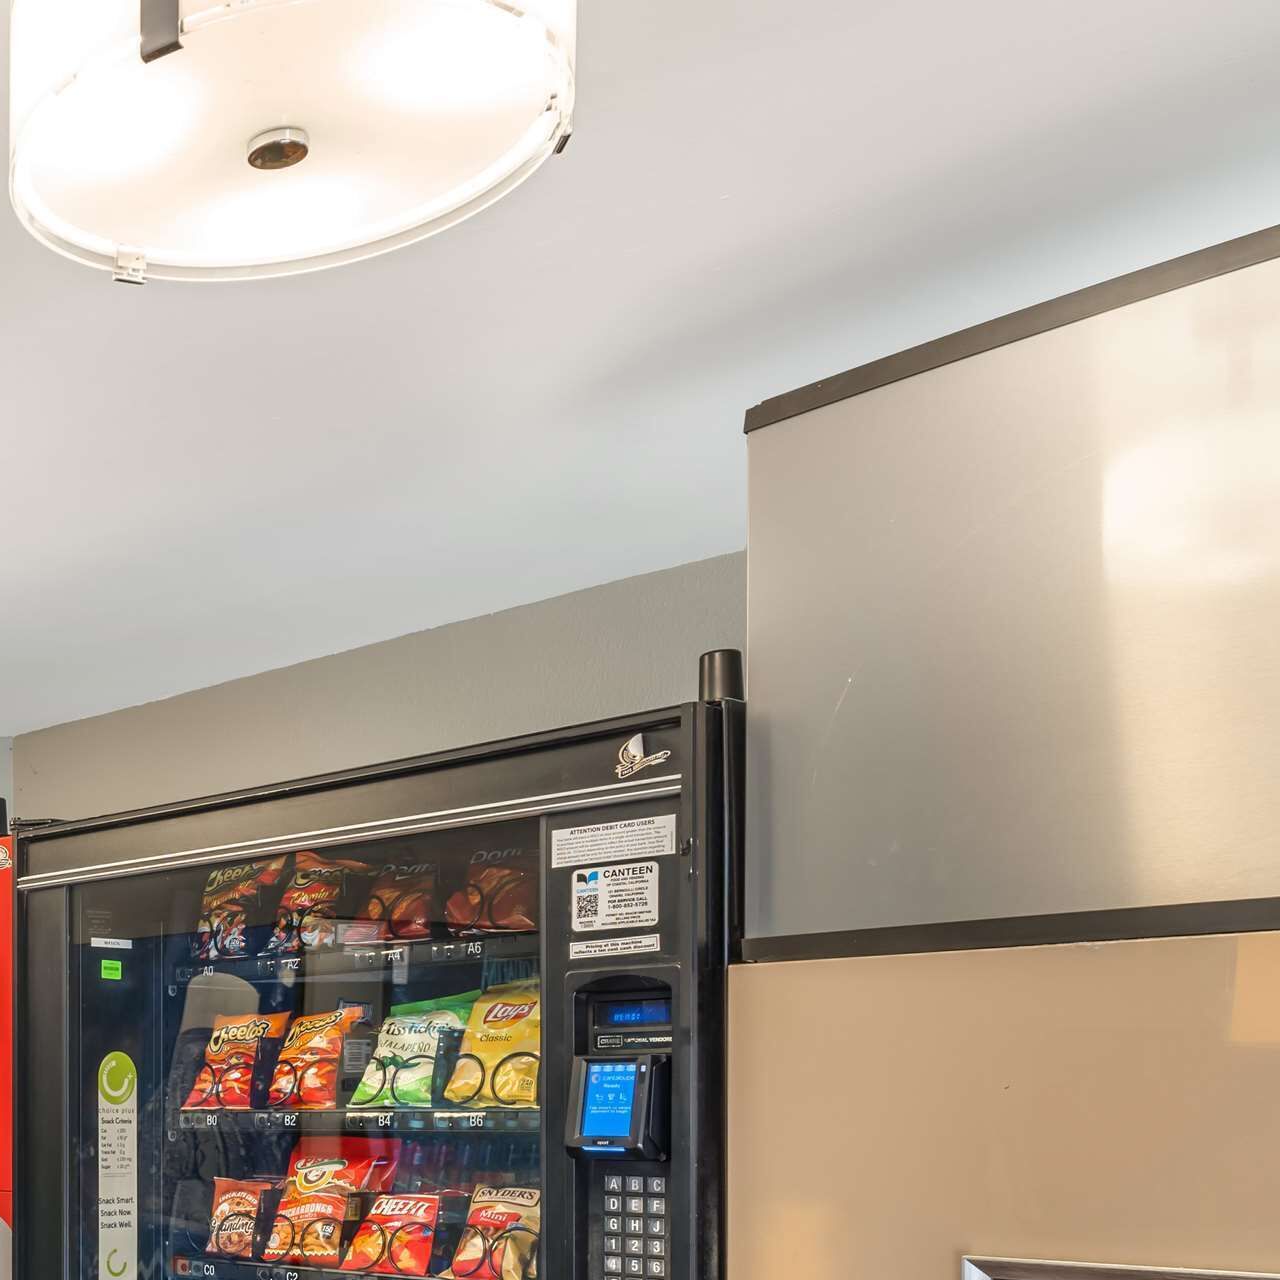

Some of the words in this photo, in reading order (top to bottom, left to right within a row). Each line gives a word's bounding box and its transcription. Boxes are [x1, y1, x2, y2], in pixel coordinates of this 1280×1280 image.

[570, 826, 601, 836] ATTENTION
[636, 819, 655, 827] USERS
[603, 865, 653, 879] CANTEEN
[468, 943, 481, 954] A6
[388, 952, 400, 960] A4
[288, 959, 299, 970] A2
[203, 966, 213, 976] A0
[491, 1004, 529, 1022] Lay's
[208, 1019, 271, 1055] Cheetos
[479, 1032, 512, 1042] Classic
[207, 1115, 217, 1126] B0
[284, 1115, 296, 1126] B2
[378, 1115, 391, 1126] B4
[469, 1115, 483, 1126] B6
[609, 1178, 618, 1191] A
[631, 1180, 639, 1191] B
[653, 1180, 661, 1192] C
[478, 1188, 536, 1200] SNYDER'S
[370, 1198, 432, 1217] CHEEZ-IT
[610, 1199, 618, 1210] D
[632, 1200, 638, 1210] E
[653, 1201, 660, 1211] F
[479, 1209, 508, 1221] Mini
[610, 1219, 617, 1230] G
[631, 1220, 639, 1231] H
[653, 1221, 660, 1232] J
[204, 1265, 215, 1276] C0
